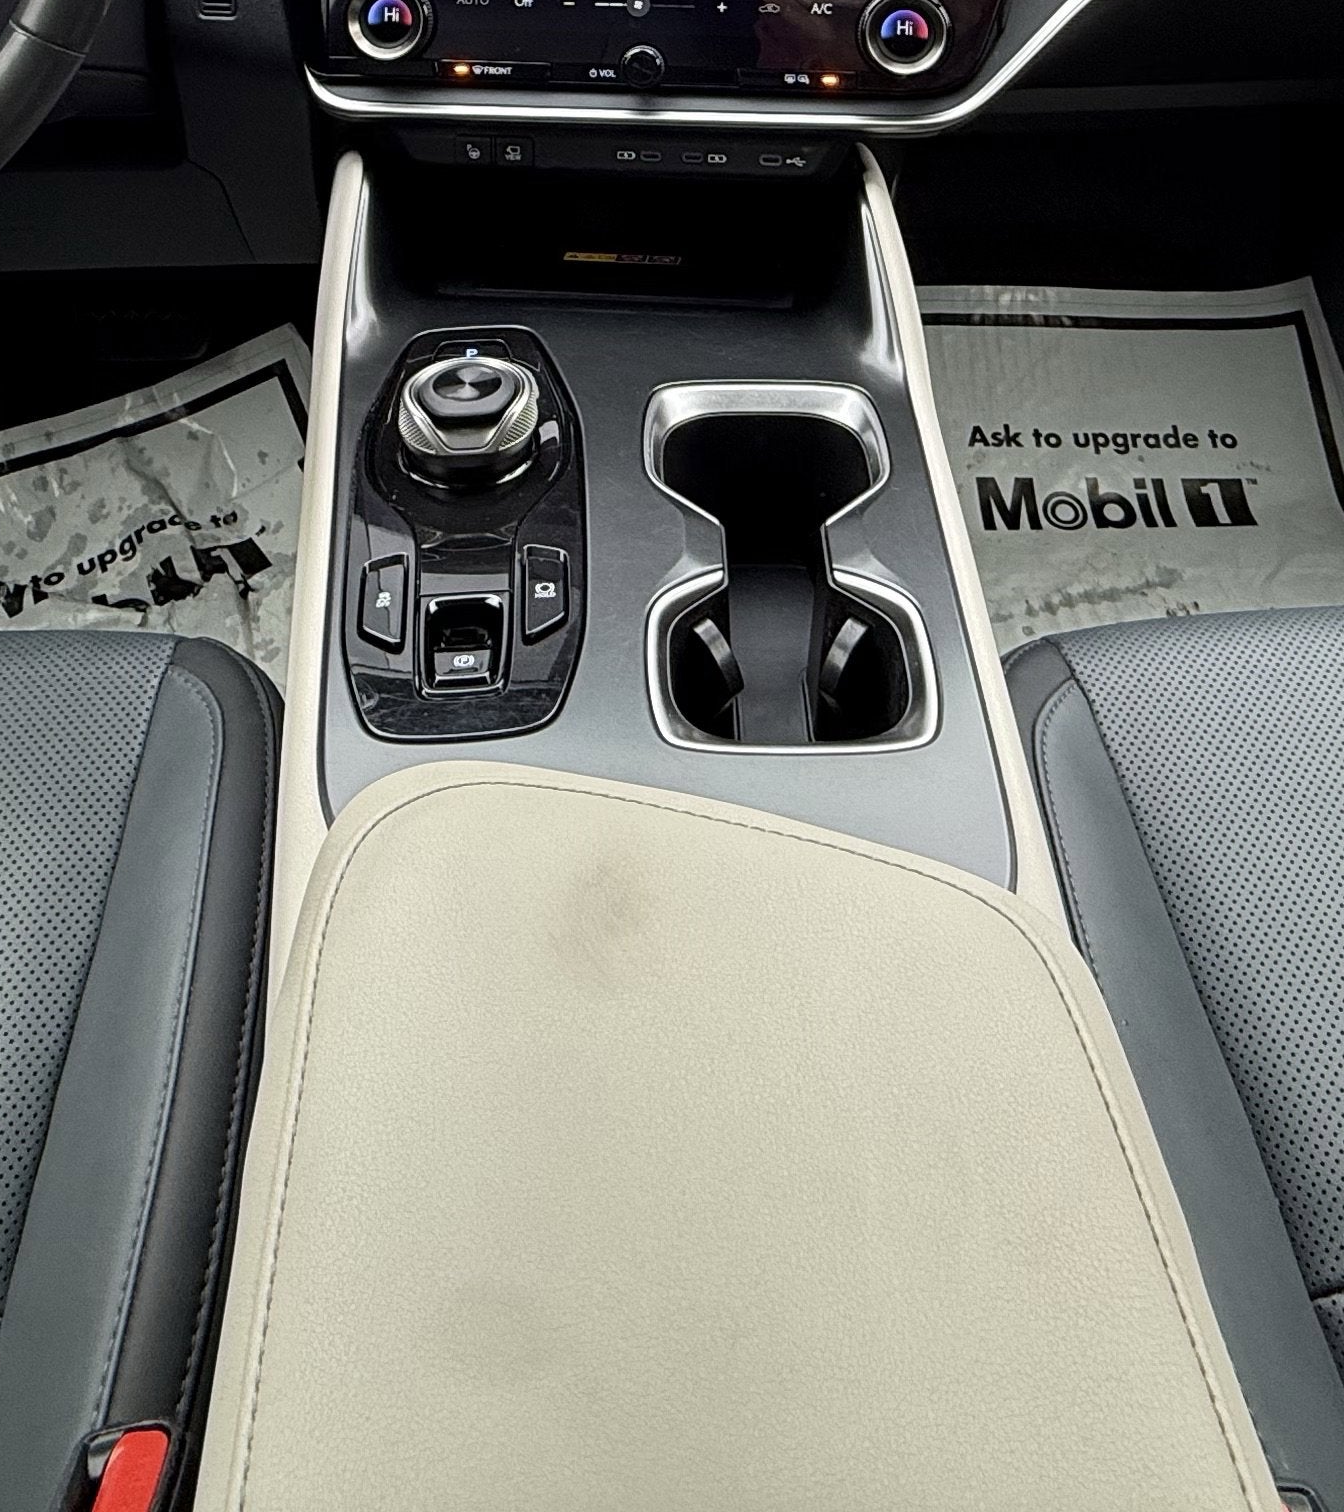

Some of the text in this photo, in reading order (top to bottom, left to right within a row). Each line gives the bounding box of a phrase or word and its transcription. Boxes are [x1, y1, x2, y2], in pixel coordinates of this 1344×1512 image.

[384, 6, 400, 23] Hi
[810, 2, 833, 15] A/C
[896, 19, 914, 36] Hi
[483, 65, 513, 76] FRONT
[598, 68, 617, 79] VOL
[967, 423, 1239, 456] Ask to upgrade to
[975, 476, 1178, 531] Mobil
[29, 571, 66, 588] to
